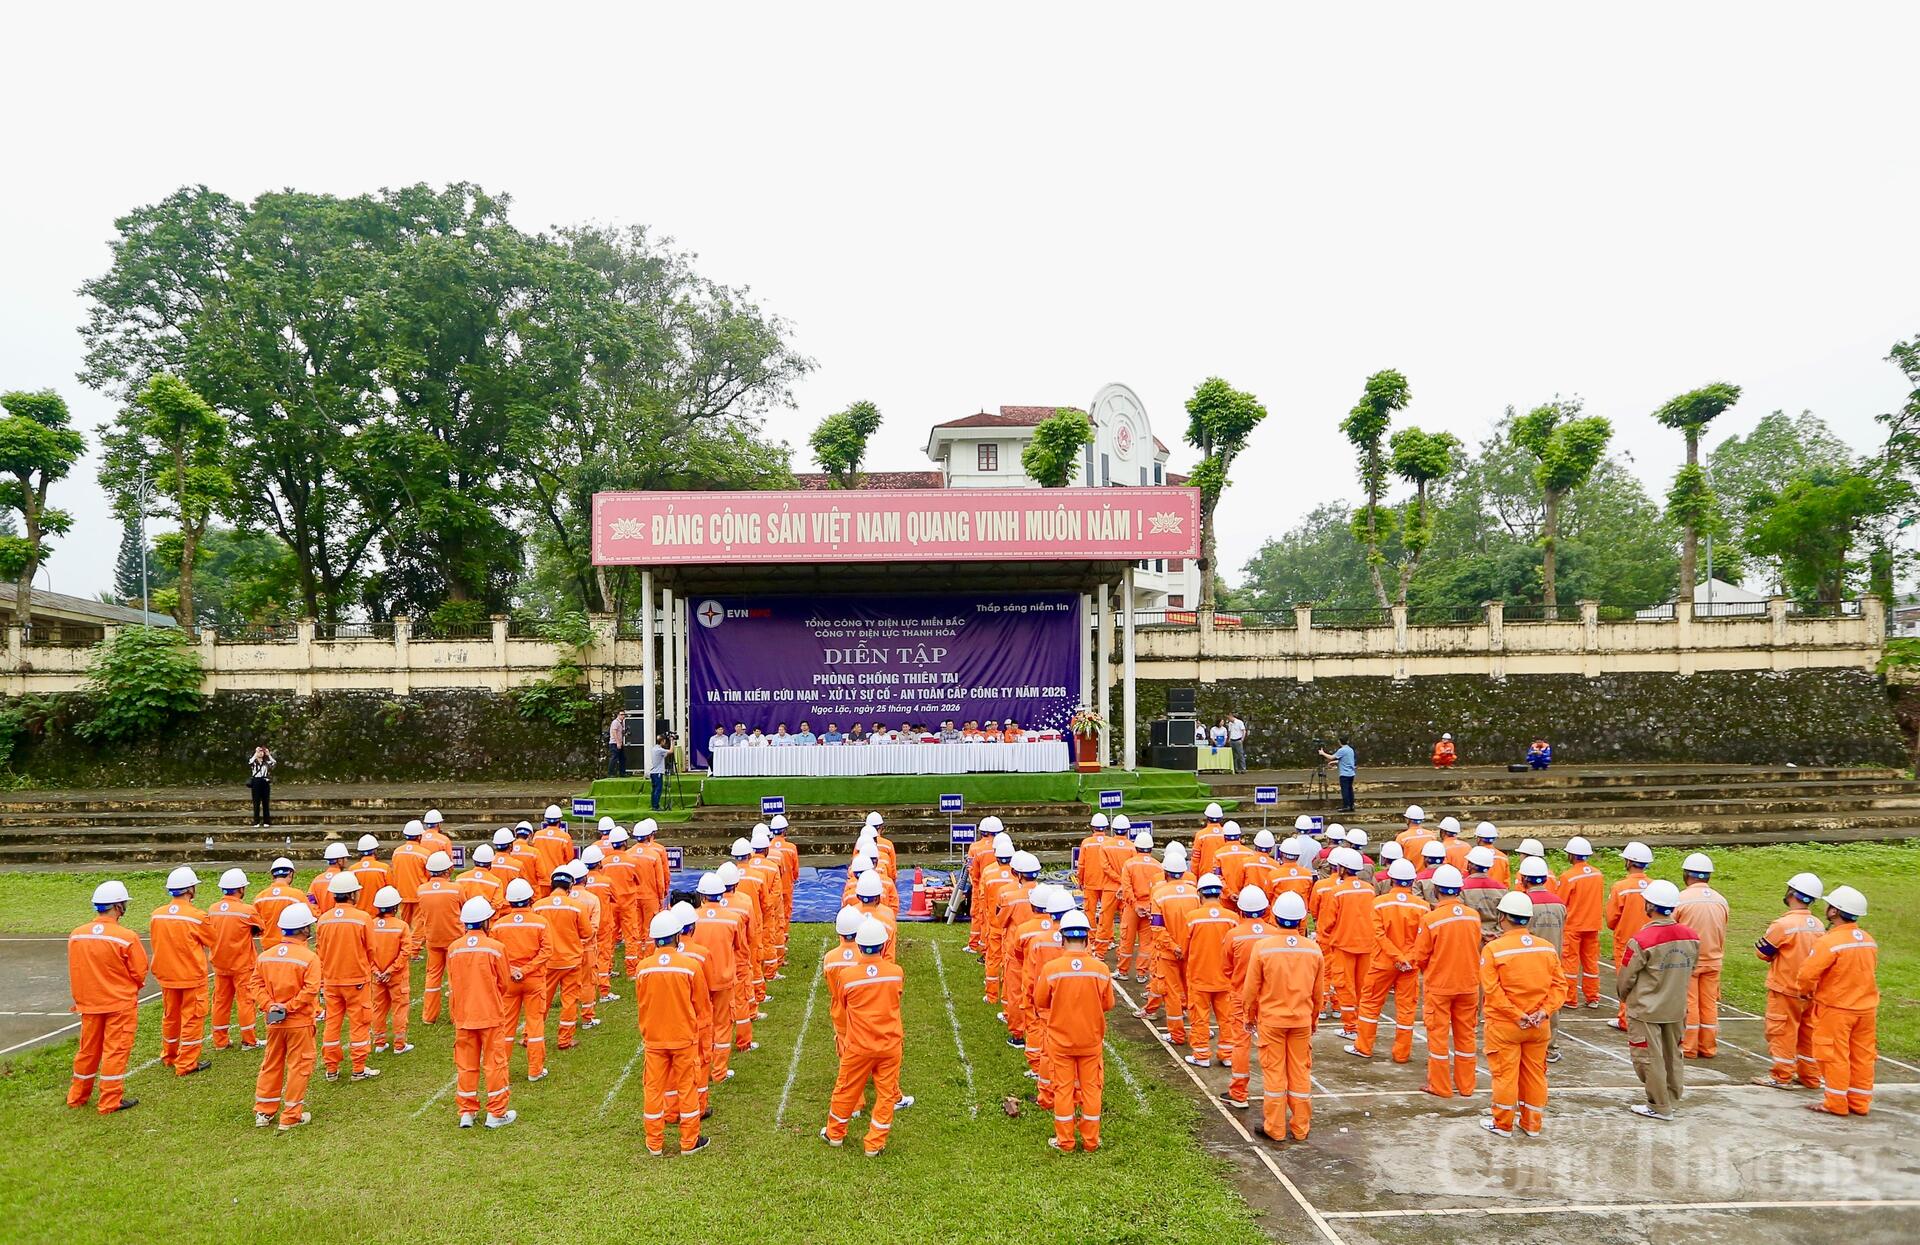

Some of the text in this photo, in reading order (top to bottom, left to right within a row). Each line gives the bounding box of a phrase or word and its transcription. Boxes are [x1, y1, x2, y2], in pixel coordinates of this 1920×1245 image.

[652, 503, 704, 545] ĐẢNG
[709, 506, 761, 551] CỘNG
[767, 502, 806, 544] SẢN
[811, 505, 851, 550] VIỆT
[856, 511, 902, 543] NAM
[906, 510, 970, 546] QUANG
[975, 510, 1020, 541] VINH
[1025, 503, 1081, 541] MUÔN
[1087, 503, 1131, 540] NĂM
[834, 618, 863, 628] CÔNG
[865, 619, 876, 627] TY
[815, 628, 844, 638] CÔNG
[846, 630, 857, 638] TY
[902, 629, 933, 637] THANH
[824, 640, 948, 668] DIỄN TẬP
[813, 670, 959, 685] PHÒNG CHỐNG THIÊN TAI
[707, 689, 721, 702] VÀ
[723, 689, 742, 702] TÌM
[745, 687, 771, 701] KIẾM
[773, 688, 794, 701] CỨU
[797, 690, 819, 703] NẠN
[845, 687, 857, 700] LÝ
[876, 686, 891, 700] CỐ
[900, 689, 915, 700] AN
[918, 687, 945, 700] TOÀN
[947, 685, 968, 699] CẤP
[970, 686, 999, 699] CÔNG
[1001, 687, 1013, 698] TY
[1015, 686, 1040, 698] NĂM
[1042, 687, 1067, 698] 2026
[876, 704, 887, 713] 25
[913, 704, 919, 712] 4
[941, 703, 961, 712] 2026
